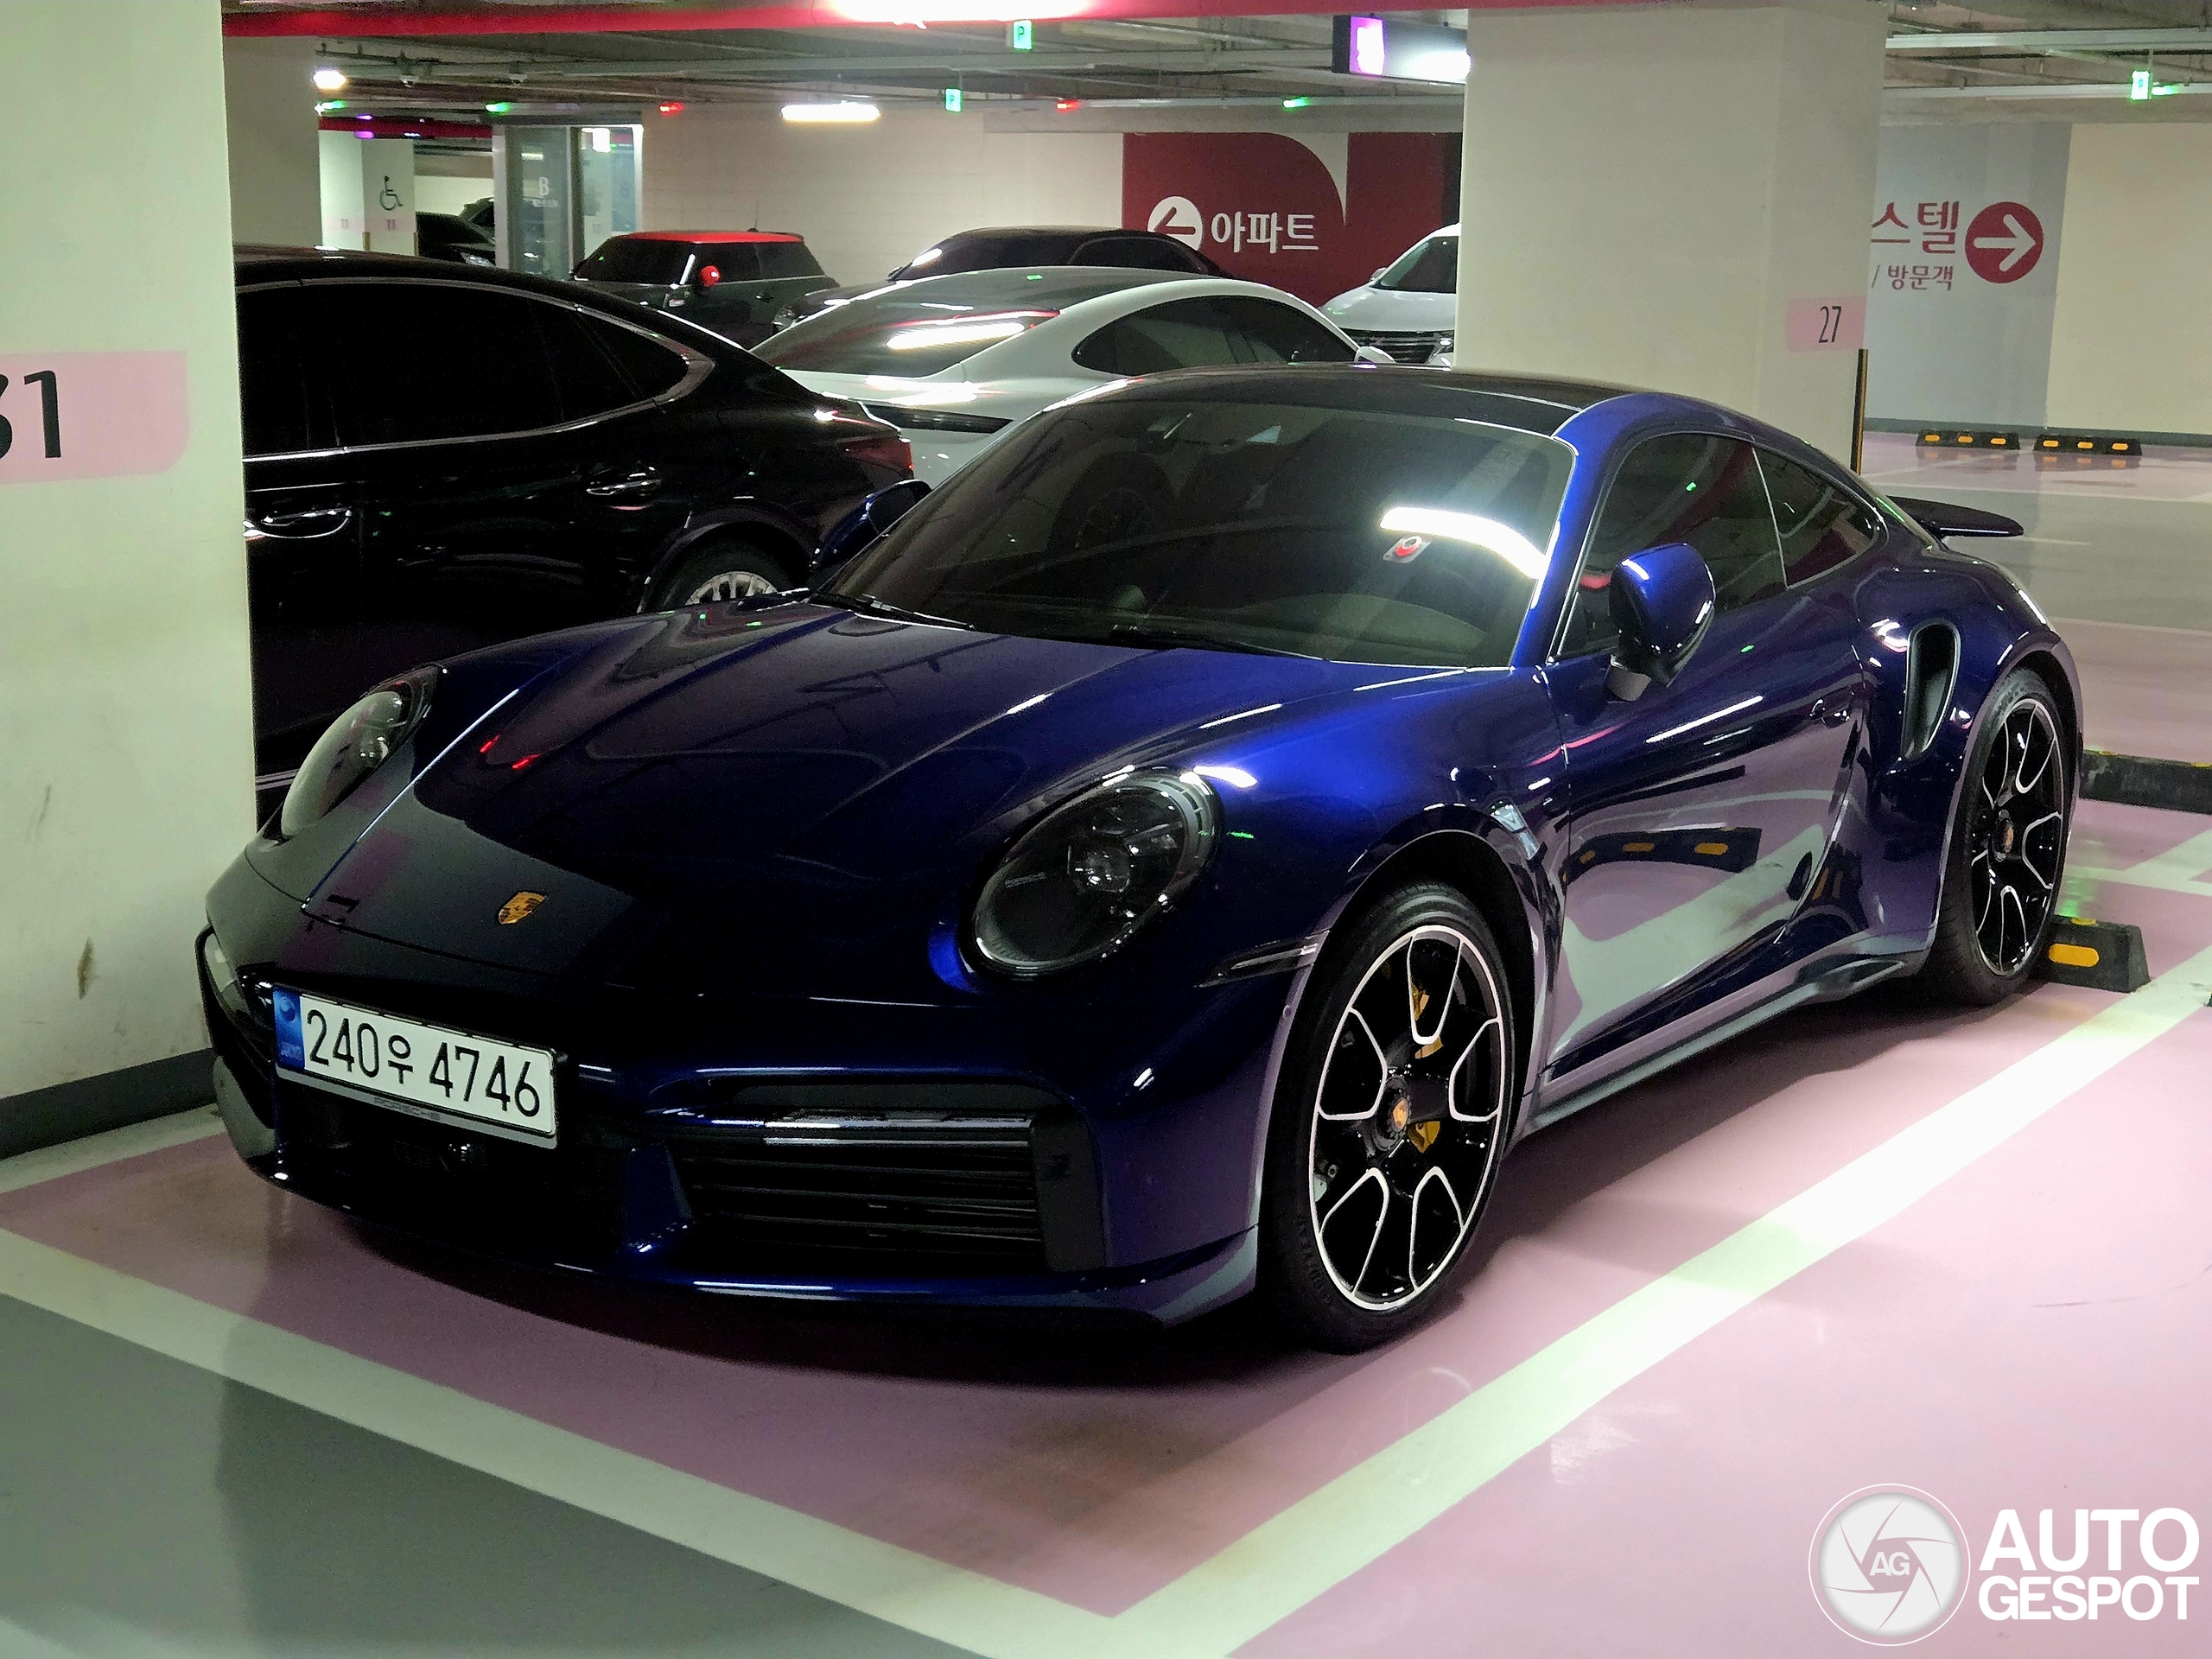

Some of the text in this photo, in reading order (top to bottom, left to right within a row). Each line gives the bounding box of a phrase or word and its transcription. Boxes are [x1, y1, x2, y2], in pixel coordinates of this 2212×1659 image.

[538, 176, 550, 196] B
[1211, 211, 1319, 254] 아파트
[1887, 264, 1954, 291] 방문객
[1818, 305, 1842, 344] 27
[306, 1008, 541, 1118] 240우 4746
